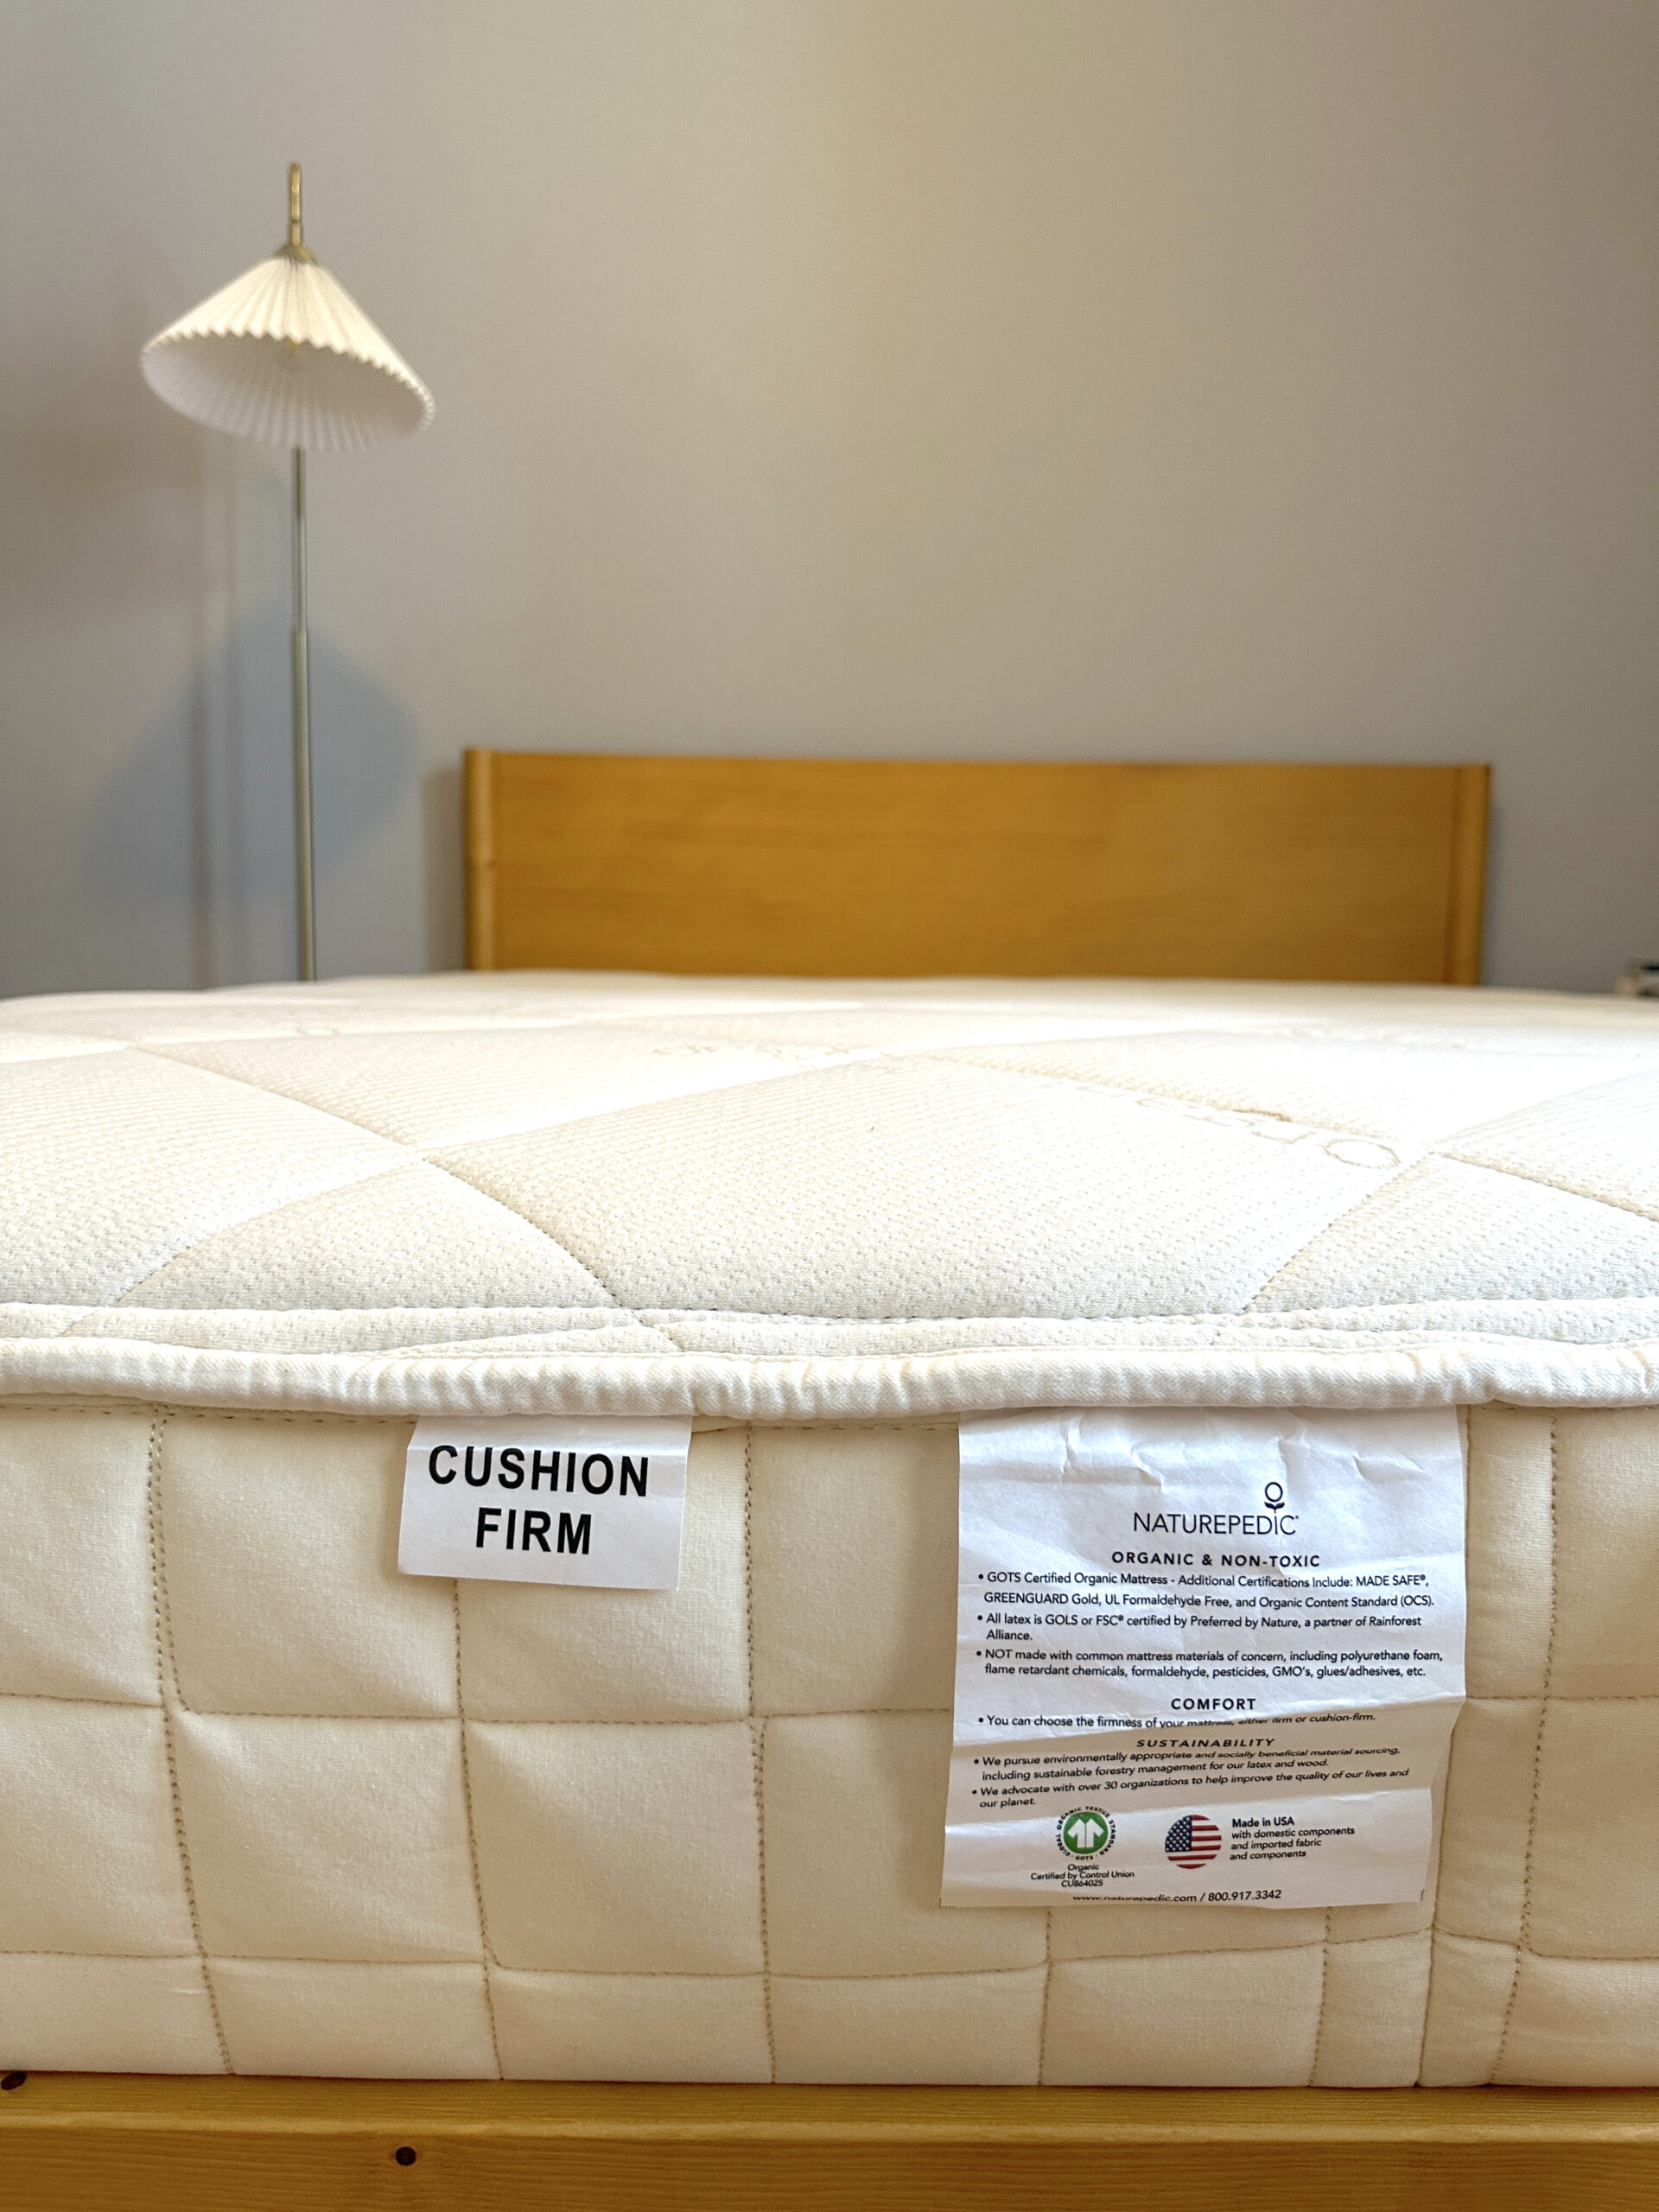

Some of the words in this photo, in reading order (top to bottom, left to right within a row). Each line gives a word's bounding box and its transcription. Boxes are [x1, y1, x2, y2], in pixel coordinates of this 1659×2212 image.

[429, 1445, 648, 1497] CUSHION
[476, 1507, 591, 1554] FIRM
[1111, 1552, 1194, 1566] ORGANIC
[1201, 1554, 1213, 1566] &
[1222, 1554, 1320, 1567] NON-TOXIC
[987, 1572, 1020, 1582] GOTS
[1024, 1573, 1071, 1583] Certified
[1074, 1573, 1117, 1586] Organic
[1121, 1573, 1167, 1585] Mattress
[1179, 1574, 1235, 1586] Additional
[1238, 1576, 1309, 1587] Certifications
[1313, 1577, 1352, 1587] Include:
[1357, 1576, 1389, 1586] MADE
[984, 1592, 1068, 1604] GREENGUARD
[1071, 1594, 1102, 1605] Gold,
[1105, 1594, 1120, 1605] UL
[1123, 1594, 1201, 1607] Formaldehyde
[1205, 1593, 1232, 1608] Free,
[1236, 1597, 1255, 1607] and
[1259, 1597, 1302, 1610] Organic
[1306, 1597, 1348, 1607] Content
[1351, 1596, 1397, 1606] Standard
[1401, 1595, 1434, 1606] (OCS).
[987, 1613, 1001, 1624] All
[1005, 1613, 1031, 1624] latex
[1034, 1614, 1042, 1624] is
[1046, 1614, 1077, 1624] GOLS
[1127, 1616, 1170, 1626] certified
[1174, 1617, 1186, 1628] by
[1191, 1616, 1242, 1628] Preferred
[1245, 1617, 1258, 1629] by
[1262, 1618, 1300, 1628] Nature,
[1313, 1618, 1352, 1629] partner
[1356, 1617, 1367, 1626] of
[1370, 1617, 1421, 1626] Rainforest
[987, 1630, 1033, 1640] Alliance.
[985, 1649, 1013, 1659] NOT
[1015, 1650, 1046, 1660] made
[1050, 1650, 1072, 1660] with
[1127, 1652, 1173, 1661] mattress
[1176, 1651, 1224, 1661] materials
[1228, 1651, 1239, 1661] of
[1243, 1653, 1286, 1662] concern,
[1290, 1651, 1337, 1662] including
[1341, 1650, 1410, 1662] polyurethane
[1414, 1649, 1442, 1661] foam,
[985, 1664, 1014, 1674] flame
[1019, 1665, 1069, 1675] retardant
[1072, 1665, 1128, 1677] chemicals,
[1131, 1666, 1209, 1678] formaldehyde,
[1212, 1667, 1268, 1679] pesticides,
[1317, 1666, 1403, 1678] glues/adhesives,
[1407, 1668, 1426, 1676] etc.
[1172, 1698, 1256, 1711] COMFORT
[988, 1715, 1008, 1726] You
[1012, 1717, 1030, 1726] can
[1034, 1715, 1073, 1726] choose
[1077, 1716, 1094, 1726] the
[1097, 1716, 1142, 1727] firmness
[1145, 1717, 1158, 1727] of
[1160, 1718, 1183, 1728] your
[1309, 1713, 1376, 1723] cushion-firm.
[1137, 1738, 1275, 1747] SUSTAINABILITY
[982, 1757, 1001, 1765] We
[1004, 1757, 1040, 1767] pursue
[1044, 1752, 1127, 1764] environmentally
[1130, 1751, 1192, 1762] appropriate
[982, 1771, 1030, 1781] including
[1033, 1768, 1092, 1778] sustainable
[1095, 1766, 1135, 1777] forestry
[1137, 1763, 1206, 1773] management
[980, 1787, 998, 1796] We
[1002, 1784, 1050, 1795] advocate
[1053, 1783, 1075, 1792] with
[1104, 1781, 1117, 1789] 30
[1120, 1778, 1189, 1789] organizations
[1205, 1776, 1229, 1785] help
[1231, 1774, 1273, 1783] improve
[1296, 1771, 1329, 1782] quality
[1001, 1798, 1036, 1808] planet.
[1232, 1818, 1259, 1828] Made
[1262, 1818, 1271, 1827] in
[1274, 1817, 1294, 1827] USA
[1232, 1829, 1250, 1839] with
[1255, 1828, 1295, 1839] domestic
[1297, 1827, 1356, 1837] components
[1230, 1840, 1248, 1849] and
[1251, 1839, 1294, 1851] imported
[1295, 1838, 1322, 1848] fabric
[1230, 1852, 1246, 1860] and
[1249, 1849, 1306, 1859] components
[1208, 1890, 1281, 1901] 800.917.3342
